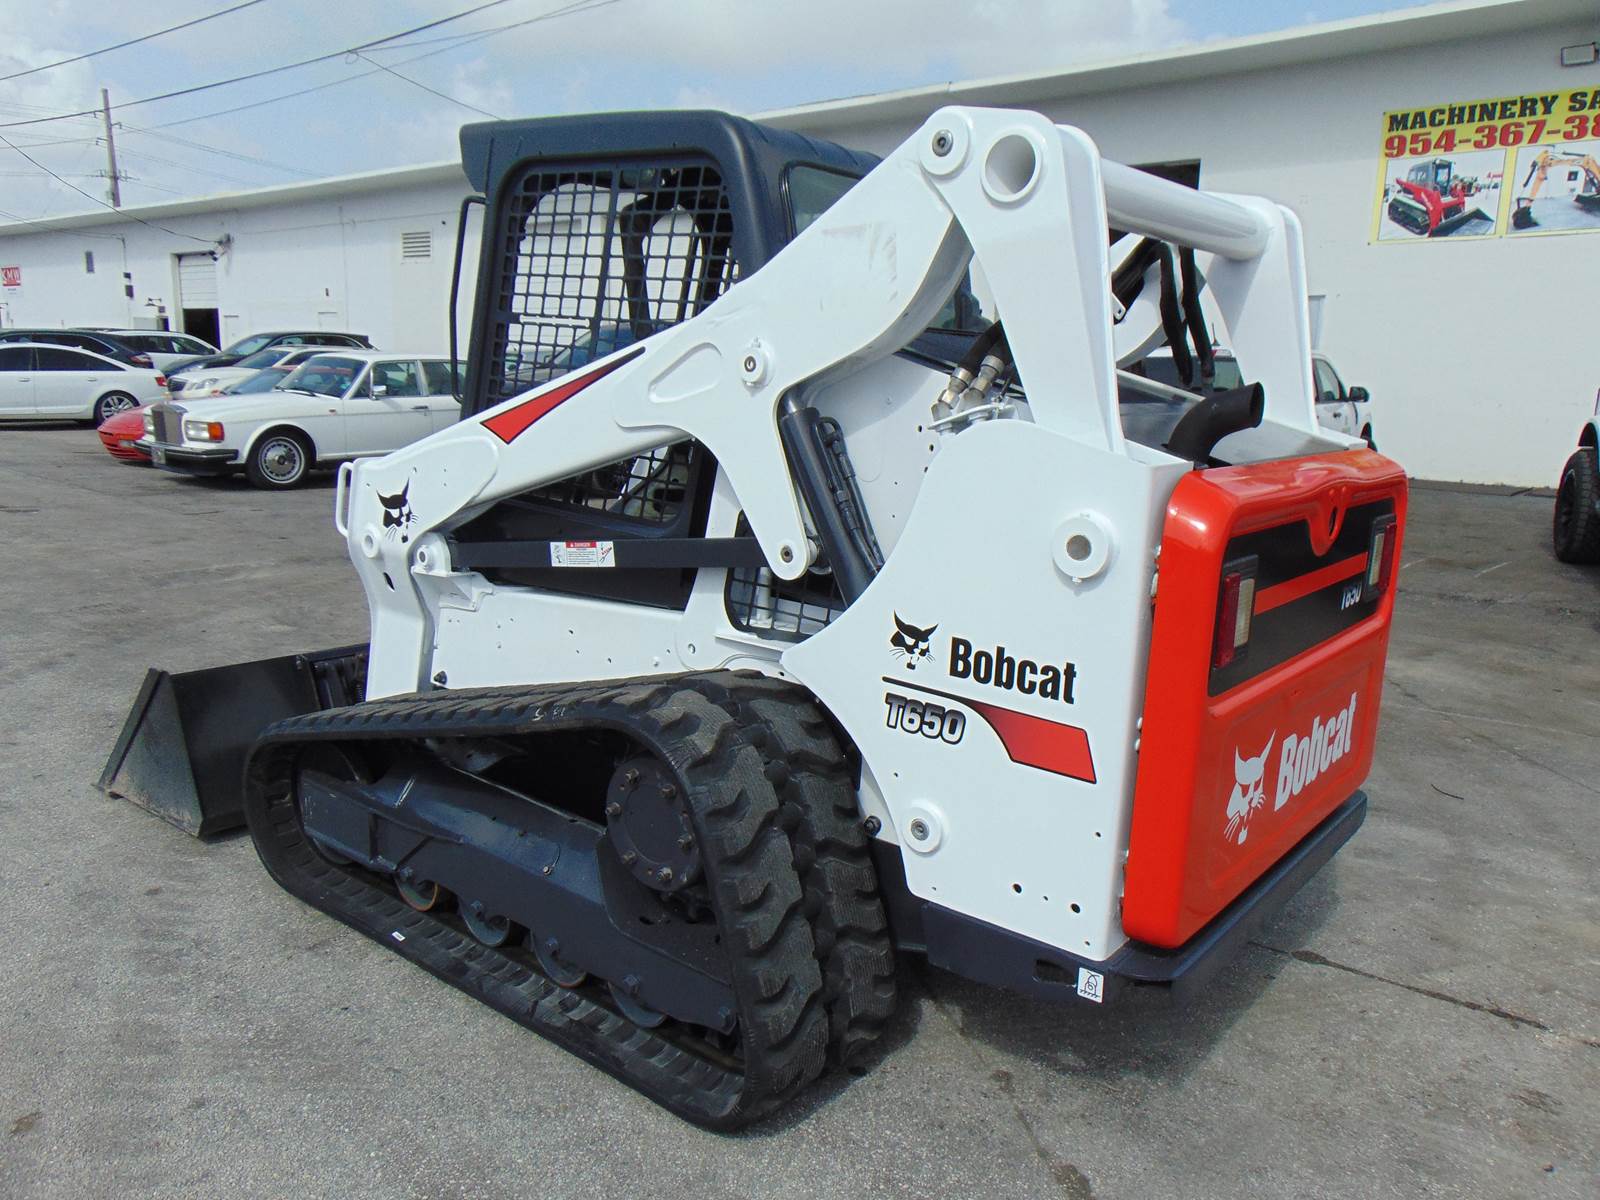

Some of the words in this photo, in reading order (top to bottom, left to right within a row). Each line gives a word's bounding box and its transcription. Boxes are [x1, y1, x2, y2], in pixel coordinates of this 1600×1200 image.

[1388, 95, 1558, 132] MACHINERY
[949, 636, 1077, 705] Bobcat
[884, 692, 966, 745] T650
[1274, 691, 1357, 812] Bobcat
